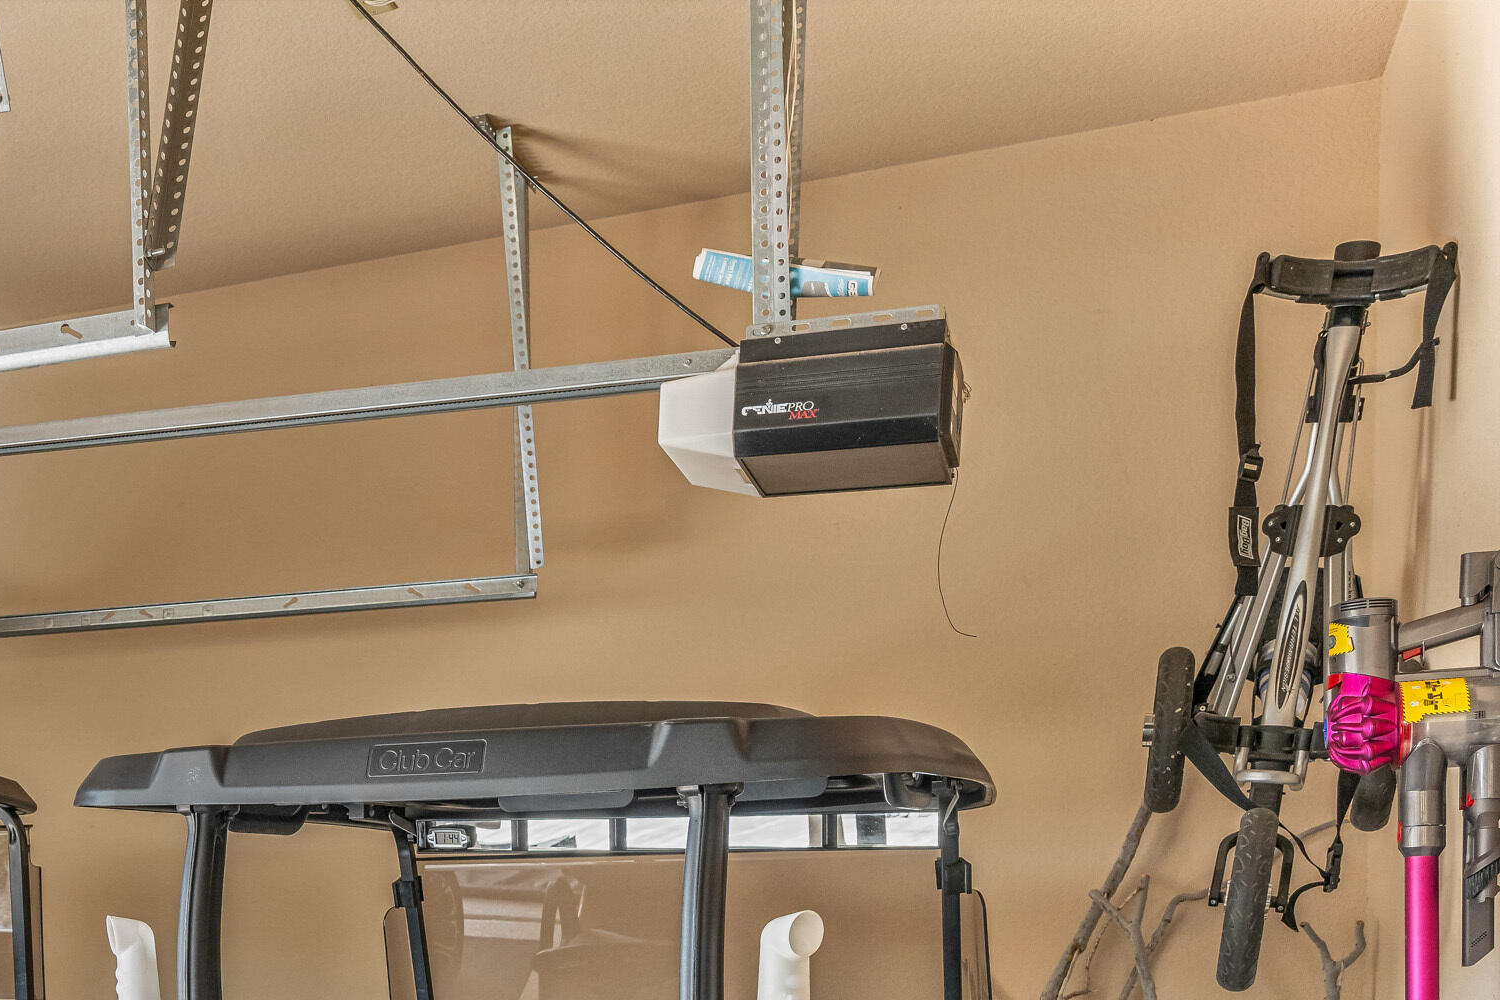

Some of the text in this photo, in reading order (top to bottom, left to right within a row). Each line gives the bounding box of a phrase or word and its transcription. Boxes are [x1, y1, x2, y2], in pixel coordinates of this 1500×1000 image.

[788, 409, 818, 420] MAX
[379, 747, 476, 772] Club Car
